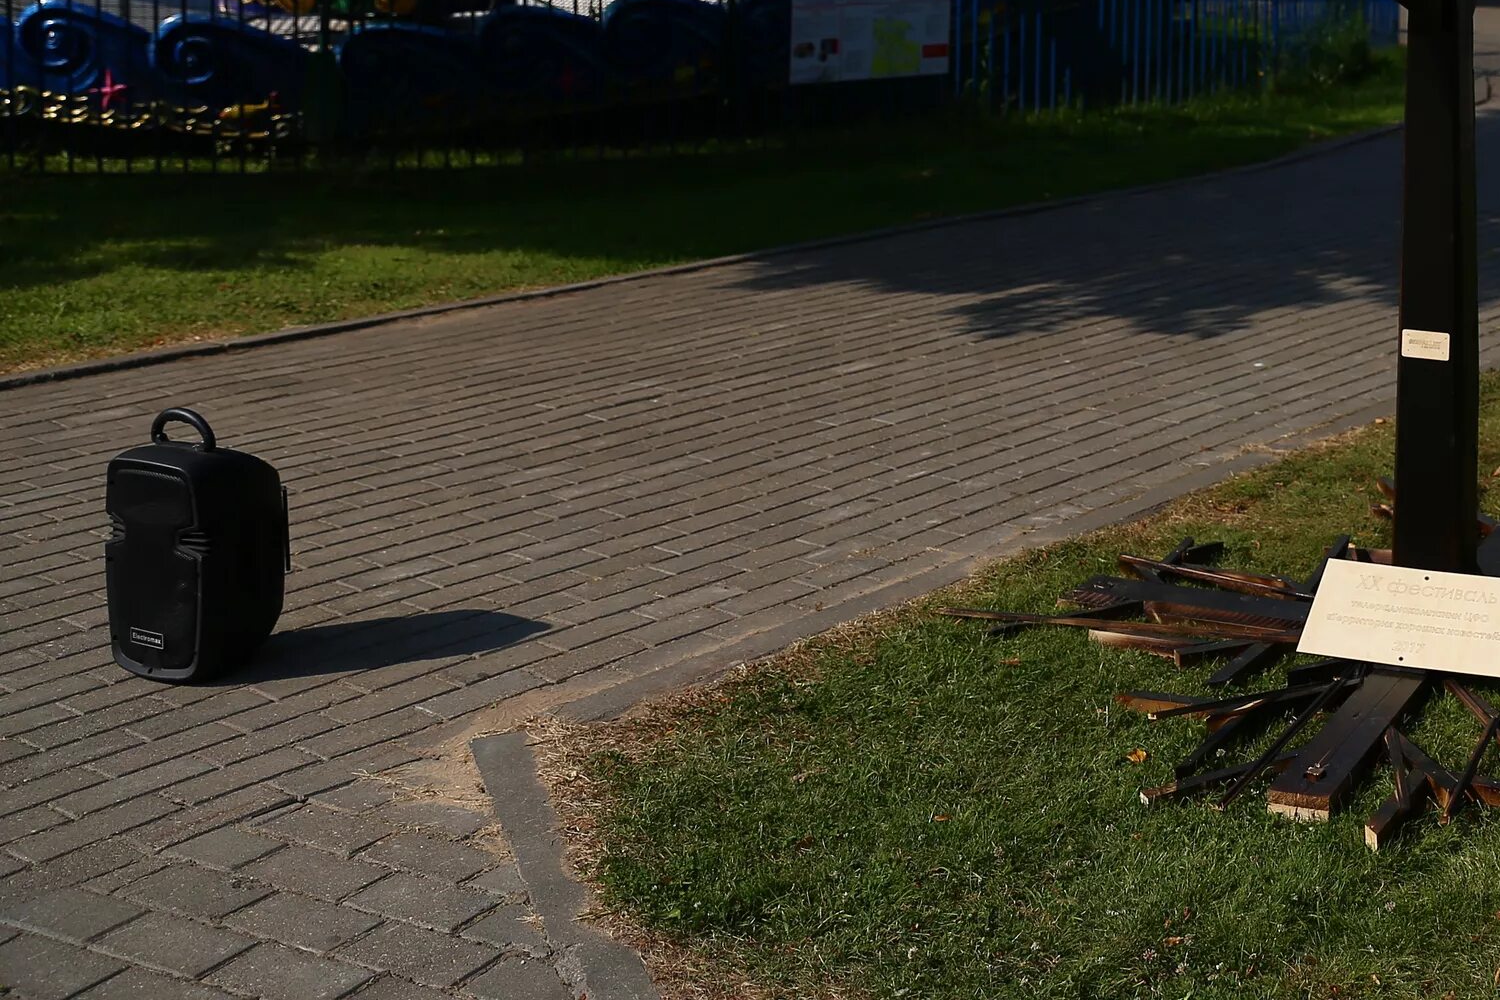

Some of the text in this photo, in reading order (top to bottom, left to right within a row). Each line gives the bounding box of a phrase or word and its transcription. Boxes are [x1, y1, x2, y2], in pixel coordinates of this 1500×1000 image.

[1386, 579, 1498, 605] фестиваль
[1395, 620, 1446, 636] хороших
[132, 632, 161, 645] Electromax
